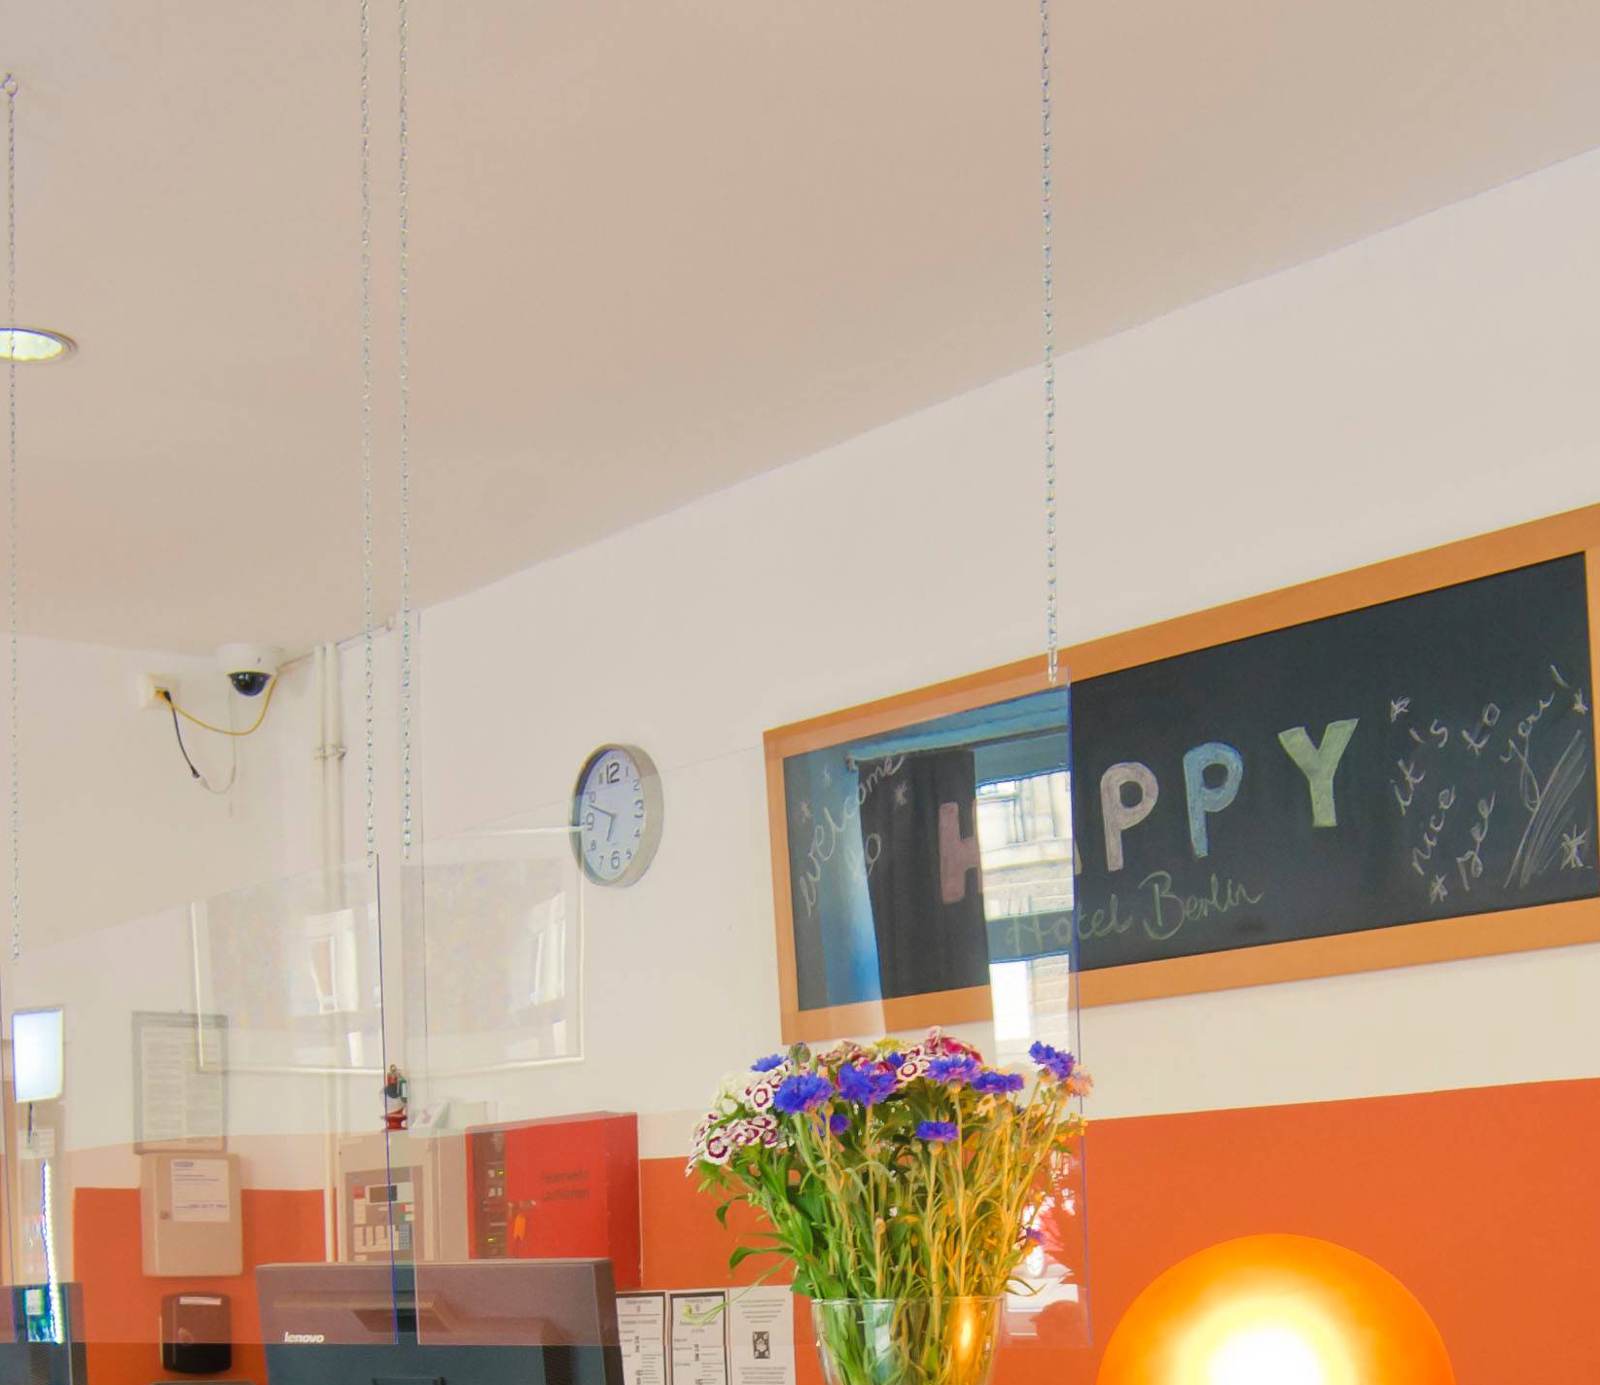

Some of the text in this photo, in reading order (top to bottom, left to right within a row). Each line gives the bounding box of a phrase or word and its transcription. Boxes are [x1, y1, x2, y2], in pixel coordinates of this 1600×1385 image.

[606, 761, 621, 785] 12
[633, 799, 645, 819] 3
[1137, 870, 1265, 941] Berlin
